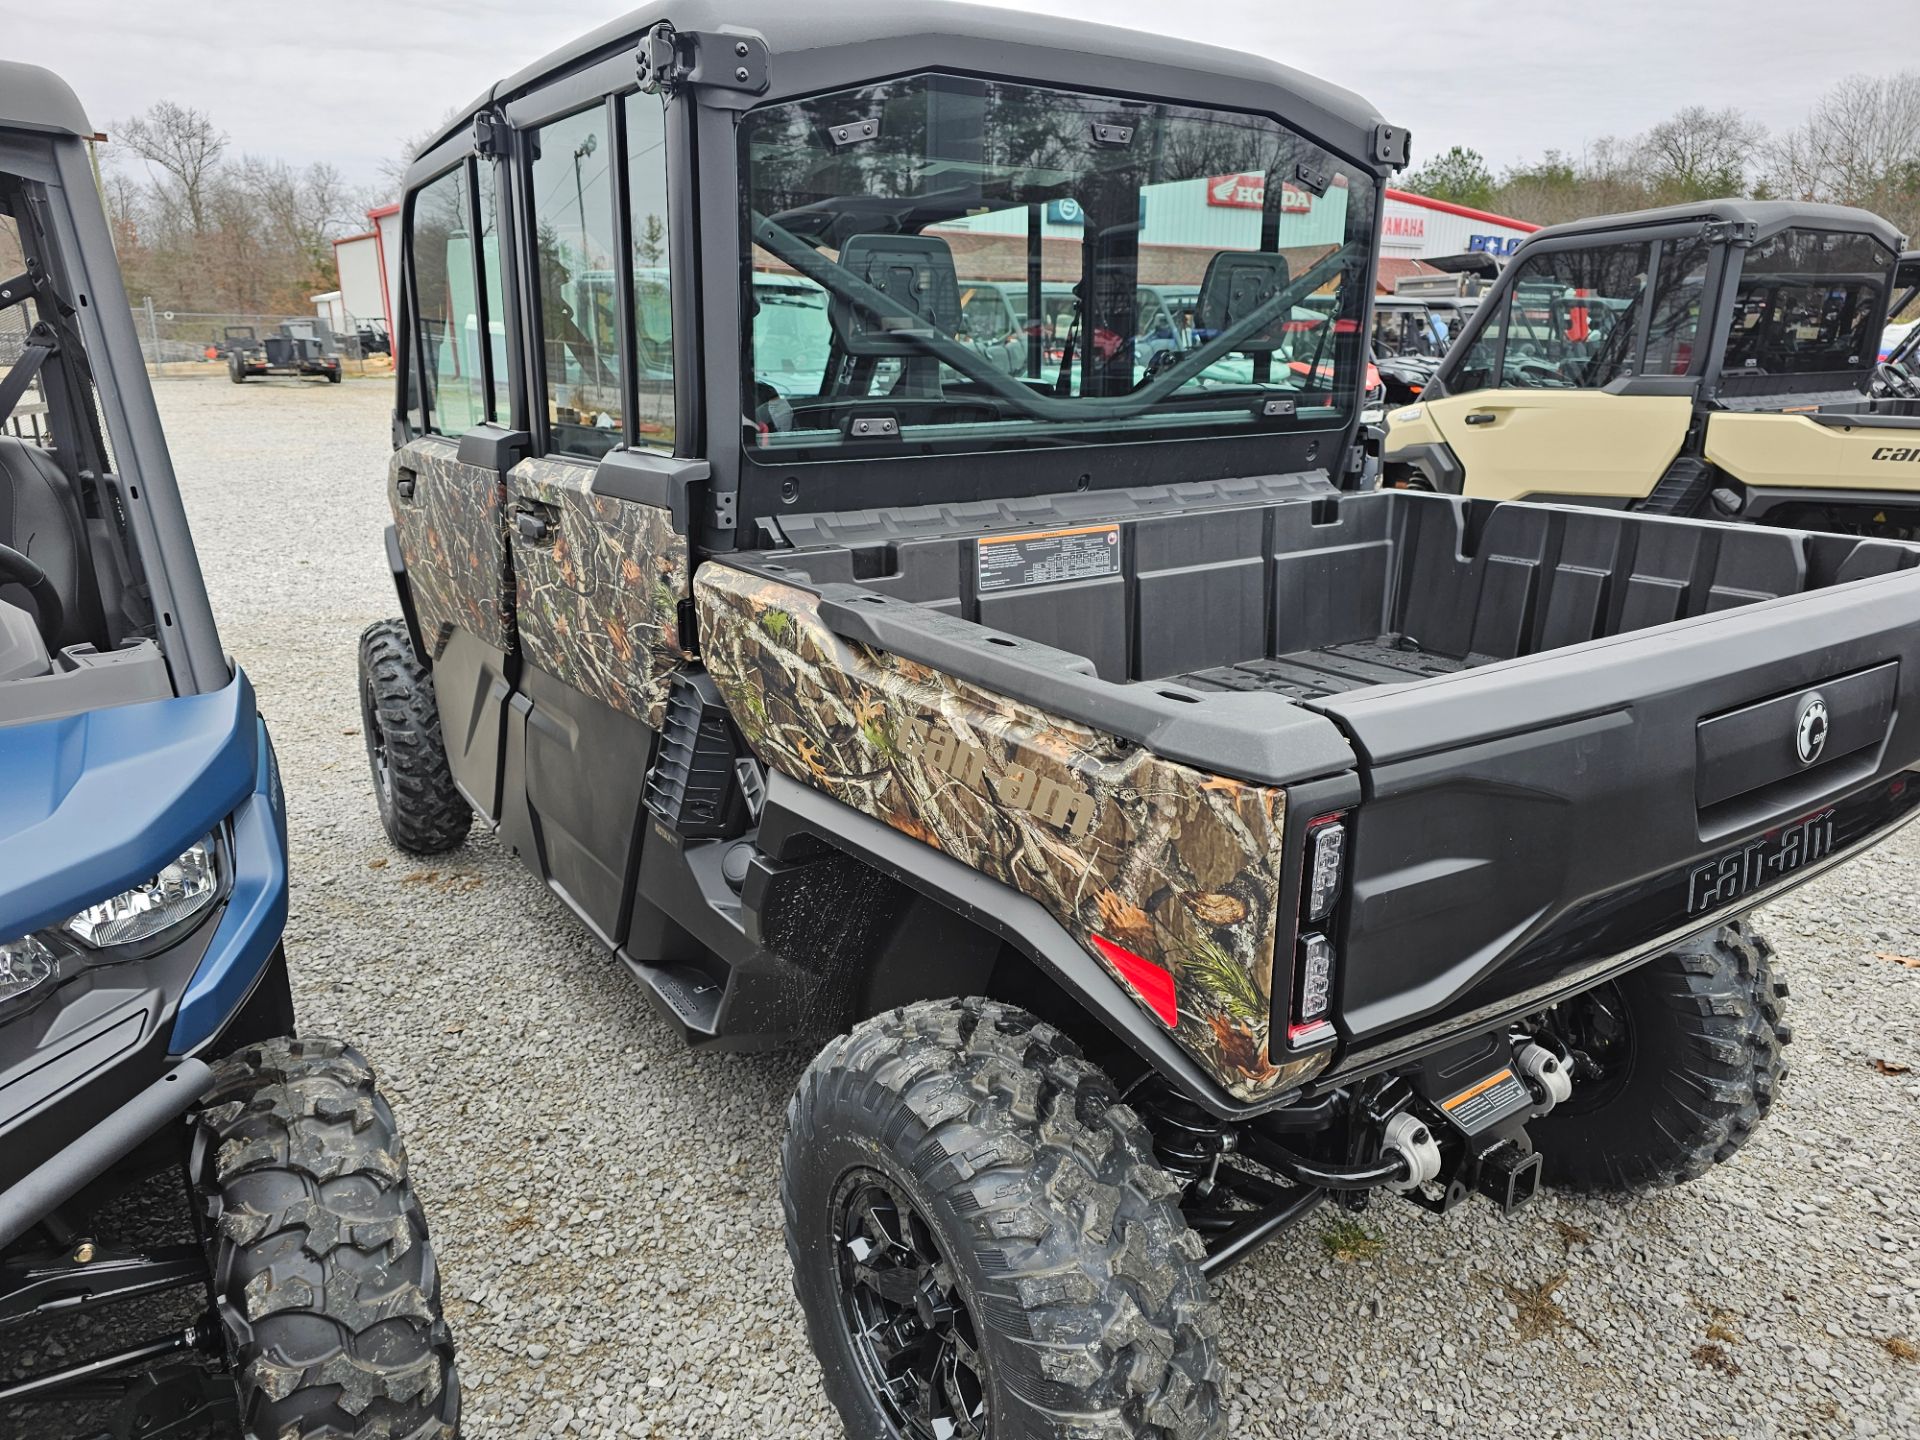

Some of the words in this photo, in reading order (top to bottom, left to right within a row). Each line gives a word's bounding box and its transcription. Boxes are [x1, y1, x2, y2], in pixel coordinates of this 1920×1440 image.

[1236, 186, 1311, 208] HODA
[896, 716, 1096, 838] can-am
[1687, 808, 1836, 915] can-am
